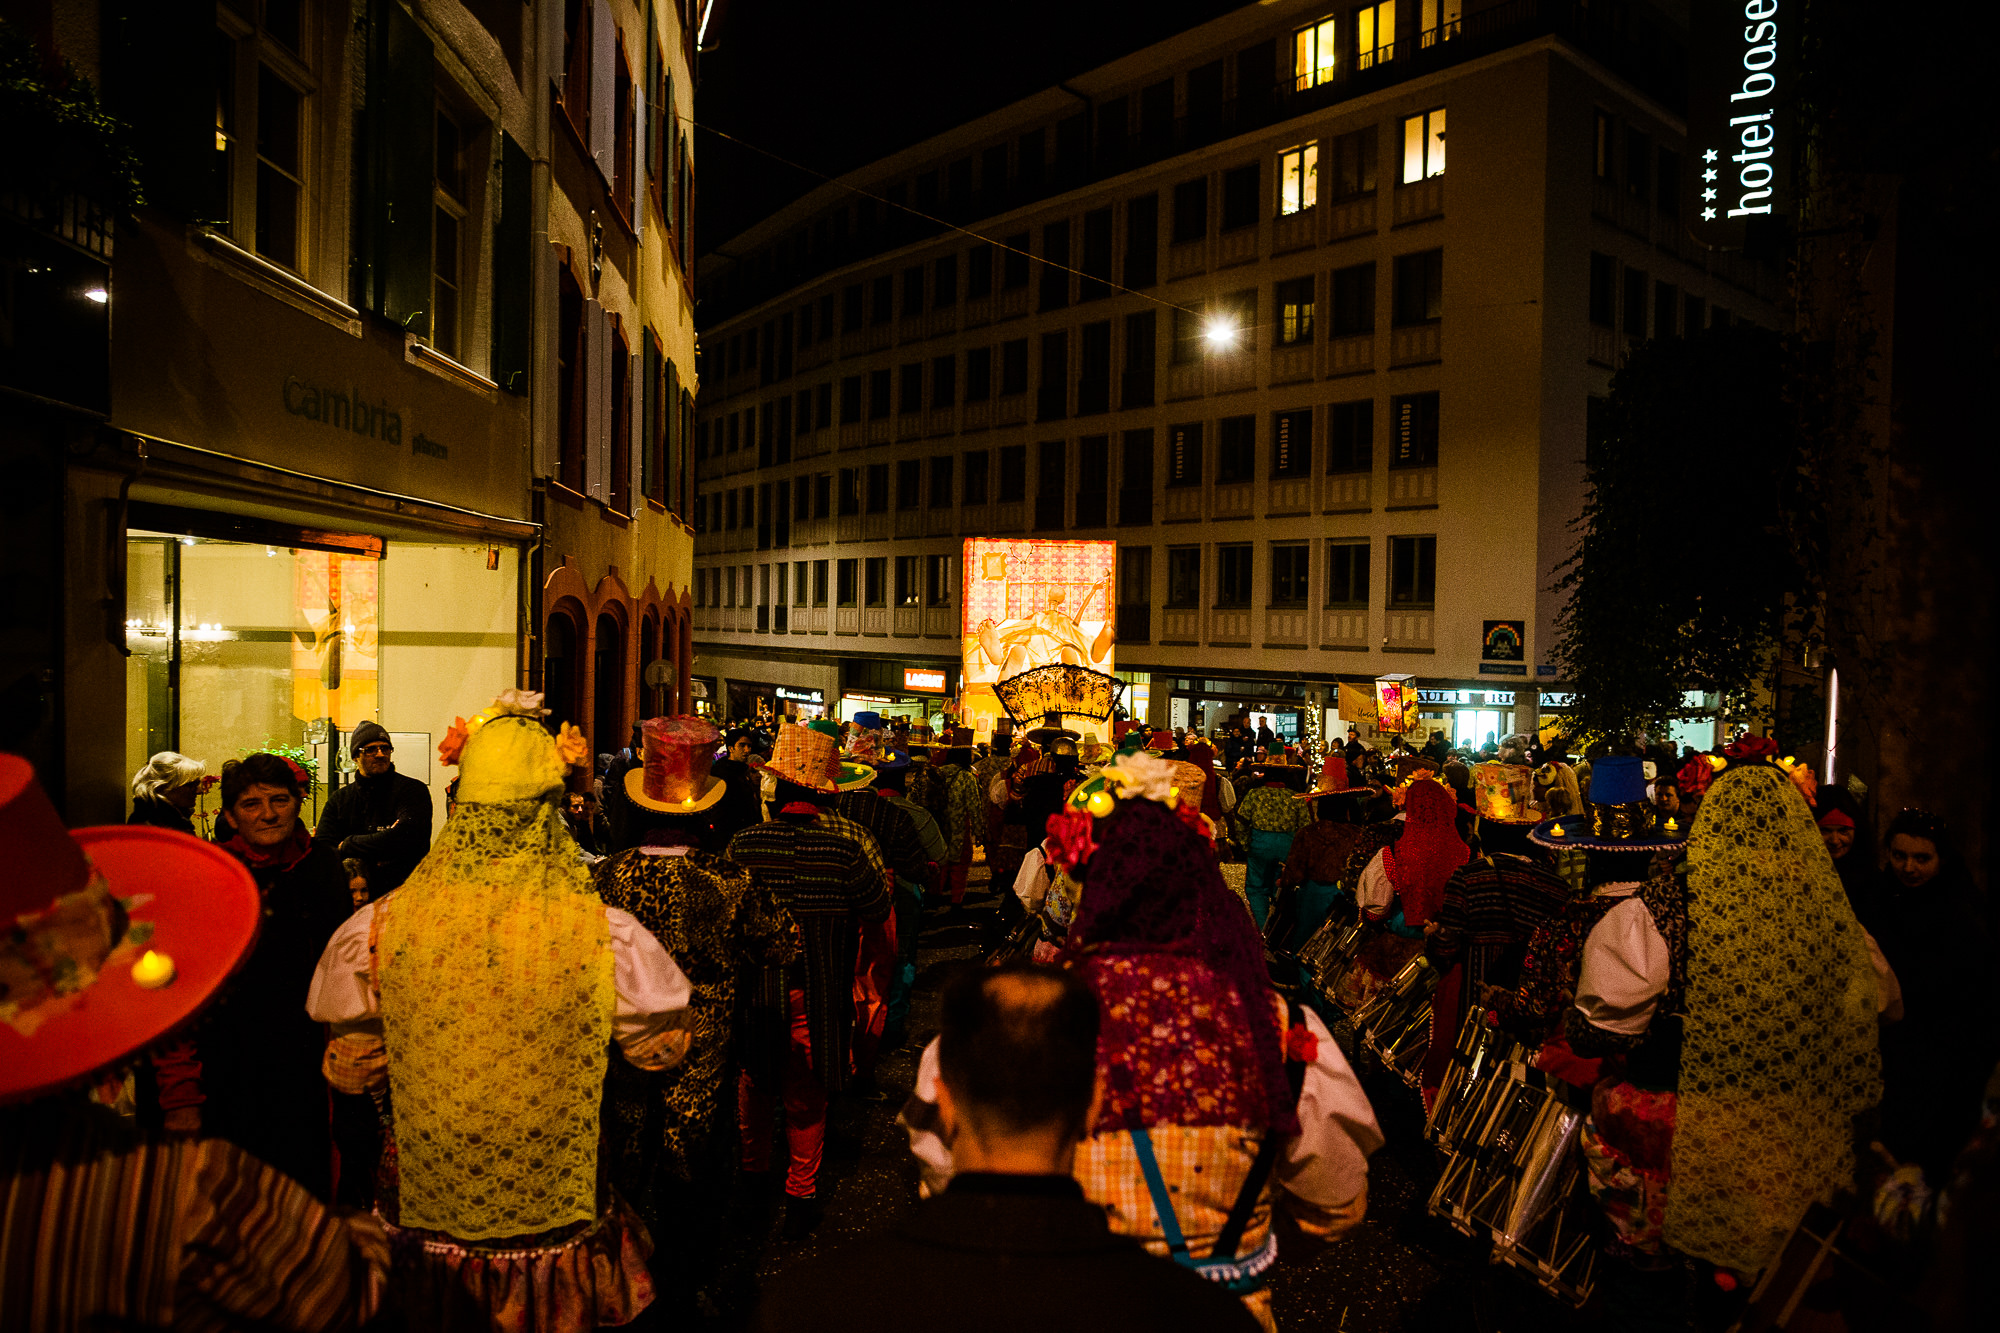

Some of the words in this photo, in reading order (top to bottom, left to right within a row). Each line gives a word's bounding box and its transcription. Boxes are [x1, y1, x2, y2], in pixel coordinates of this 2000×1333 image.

[1727, 108, 1774, 218] hotel
[283, 375, 402, 446] cambria
[1399, 403, 1412, 459] travelshop
[1175, 431, 1185, 479] travelshop
[1279, 417, 1290, 469] travelshop
